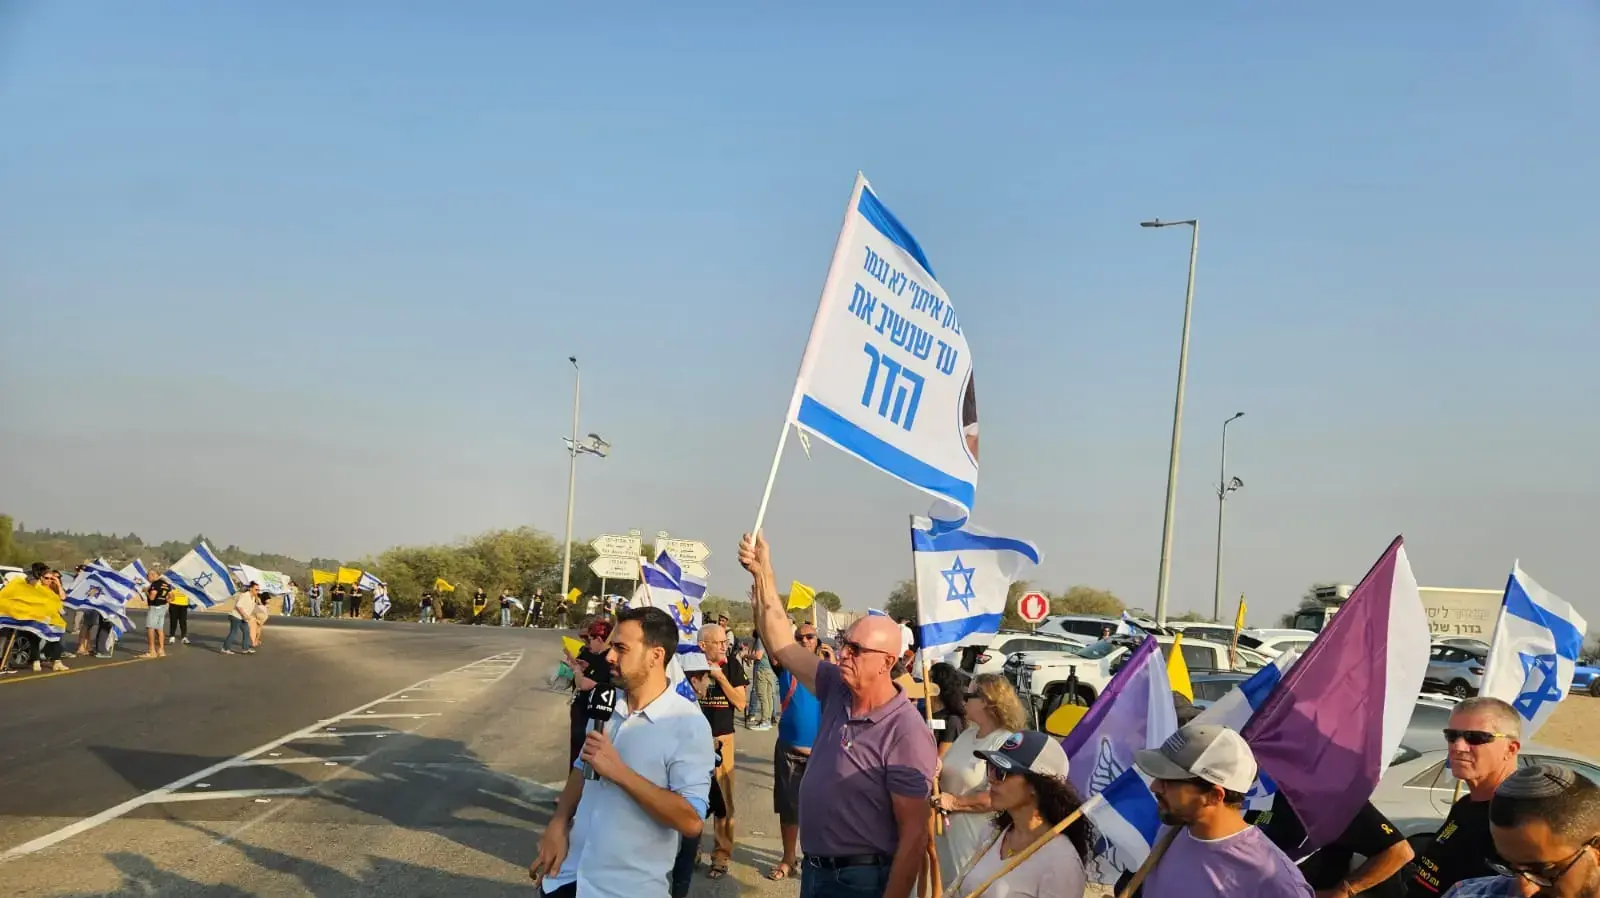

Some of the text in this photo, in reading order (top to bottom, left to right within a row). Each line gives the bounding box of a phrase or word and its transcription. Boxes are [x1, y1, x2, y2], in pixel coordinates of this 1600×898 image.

[863, 245, 890, 285] נגמר
[888, 268, 908, 296] לא
[908, 279, 944, 321] איתן"
[847, 281, 958, 376] עד שנשיב את
[861, 341, 926, 432] הדר
[1425, 603, 1449, 619] ליסי
[1454, 624, 1482, 635] בדרך
